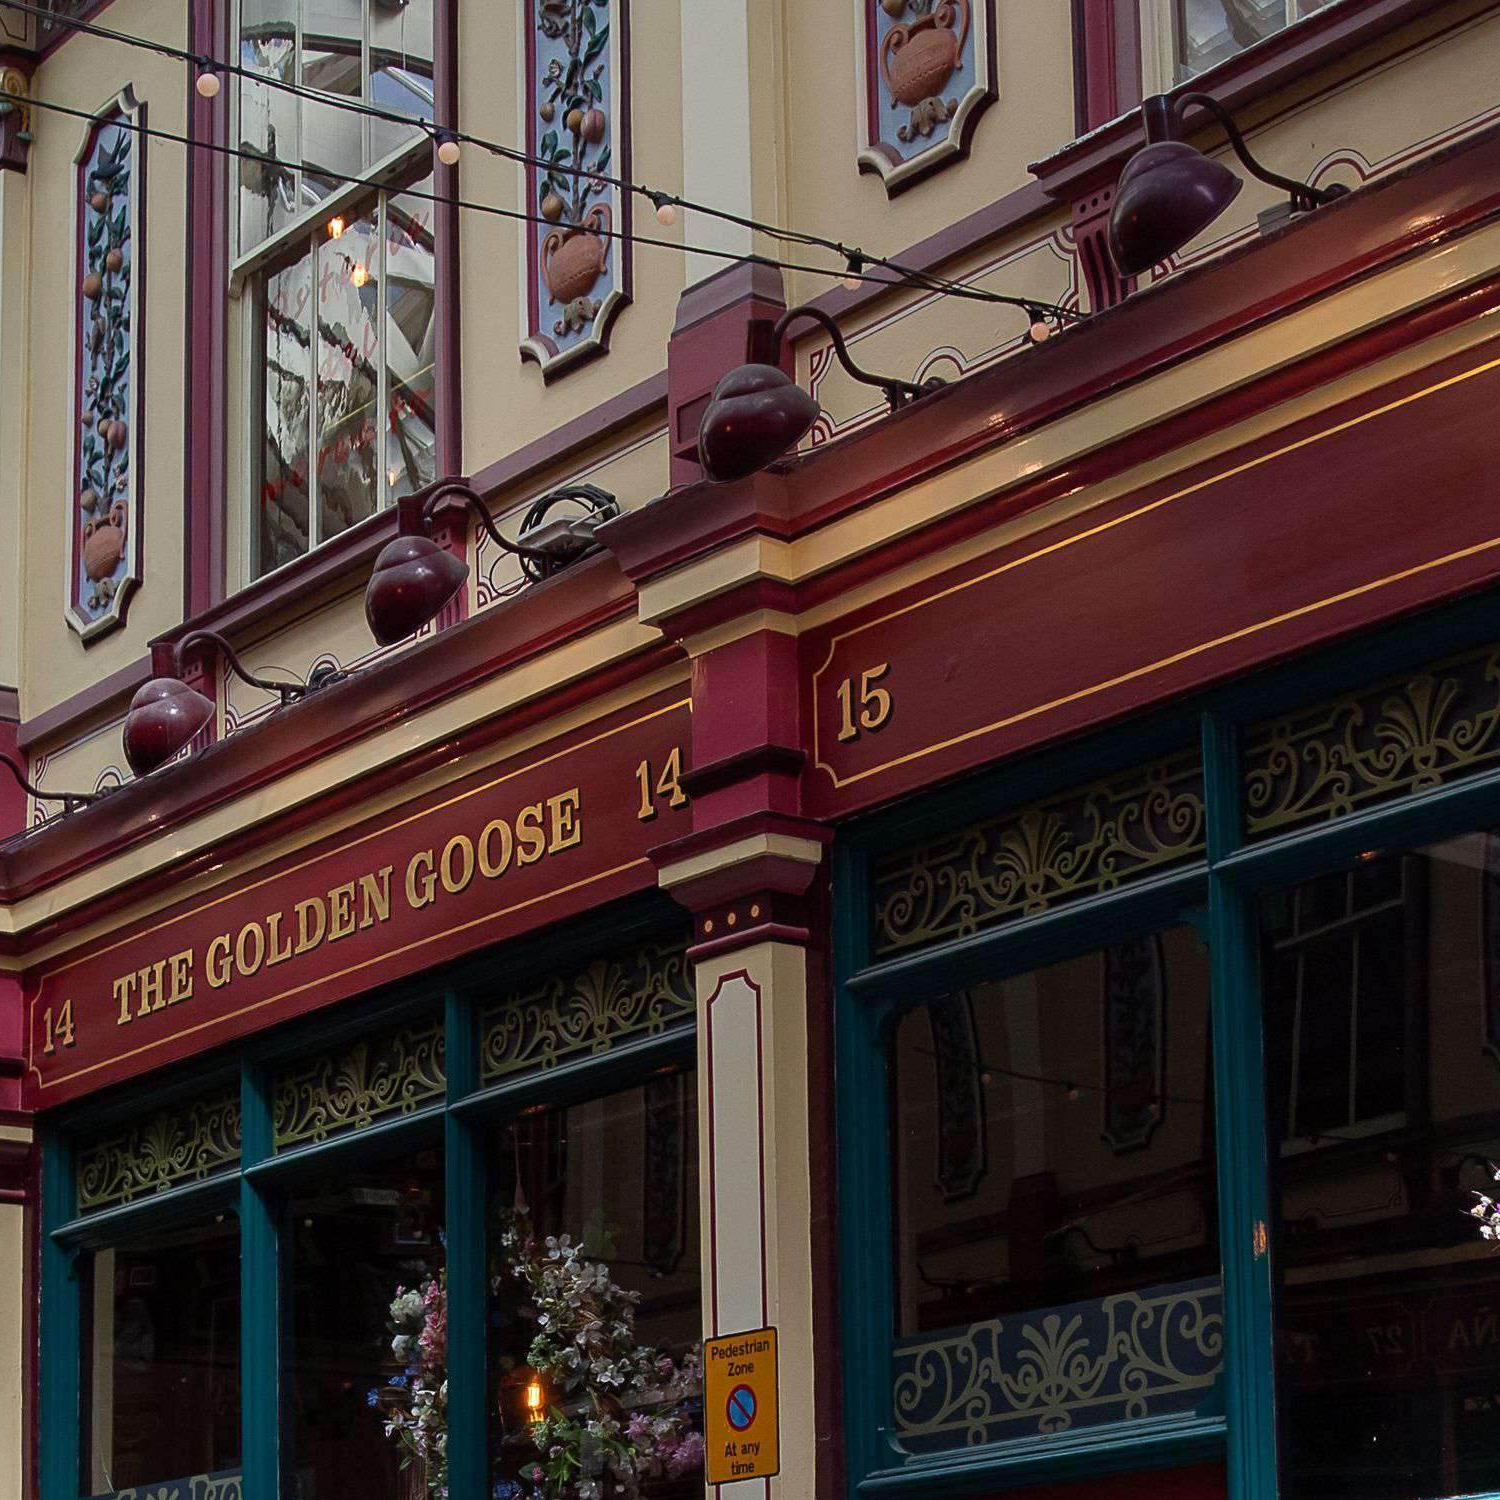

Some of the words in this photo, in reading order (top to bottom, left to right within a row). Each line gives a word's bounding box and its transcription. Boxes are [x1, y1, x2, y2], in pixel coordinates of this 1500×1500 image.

[836, 662, 894, 743] 15
[43, 999, 76, 1056] 14
[112, 949, 195, 1026] THE
[205, 864, 394, 991] GOLDEN
[404, 787, 583, 912] GOOSE
[635, 747, 689, 823] 14
[711, 1338, 770, 1360] Pedestrian
[727, 1362, 755, 1377] Zone
[724, 1442, 737, 1457] At
[740, 1440, 760, 1456] any
[731, 1460, 755, 1476] time
